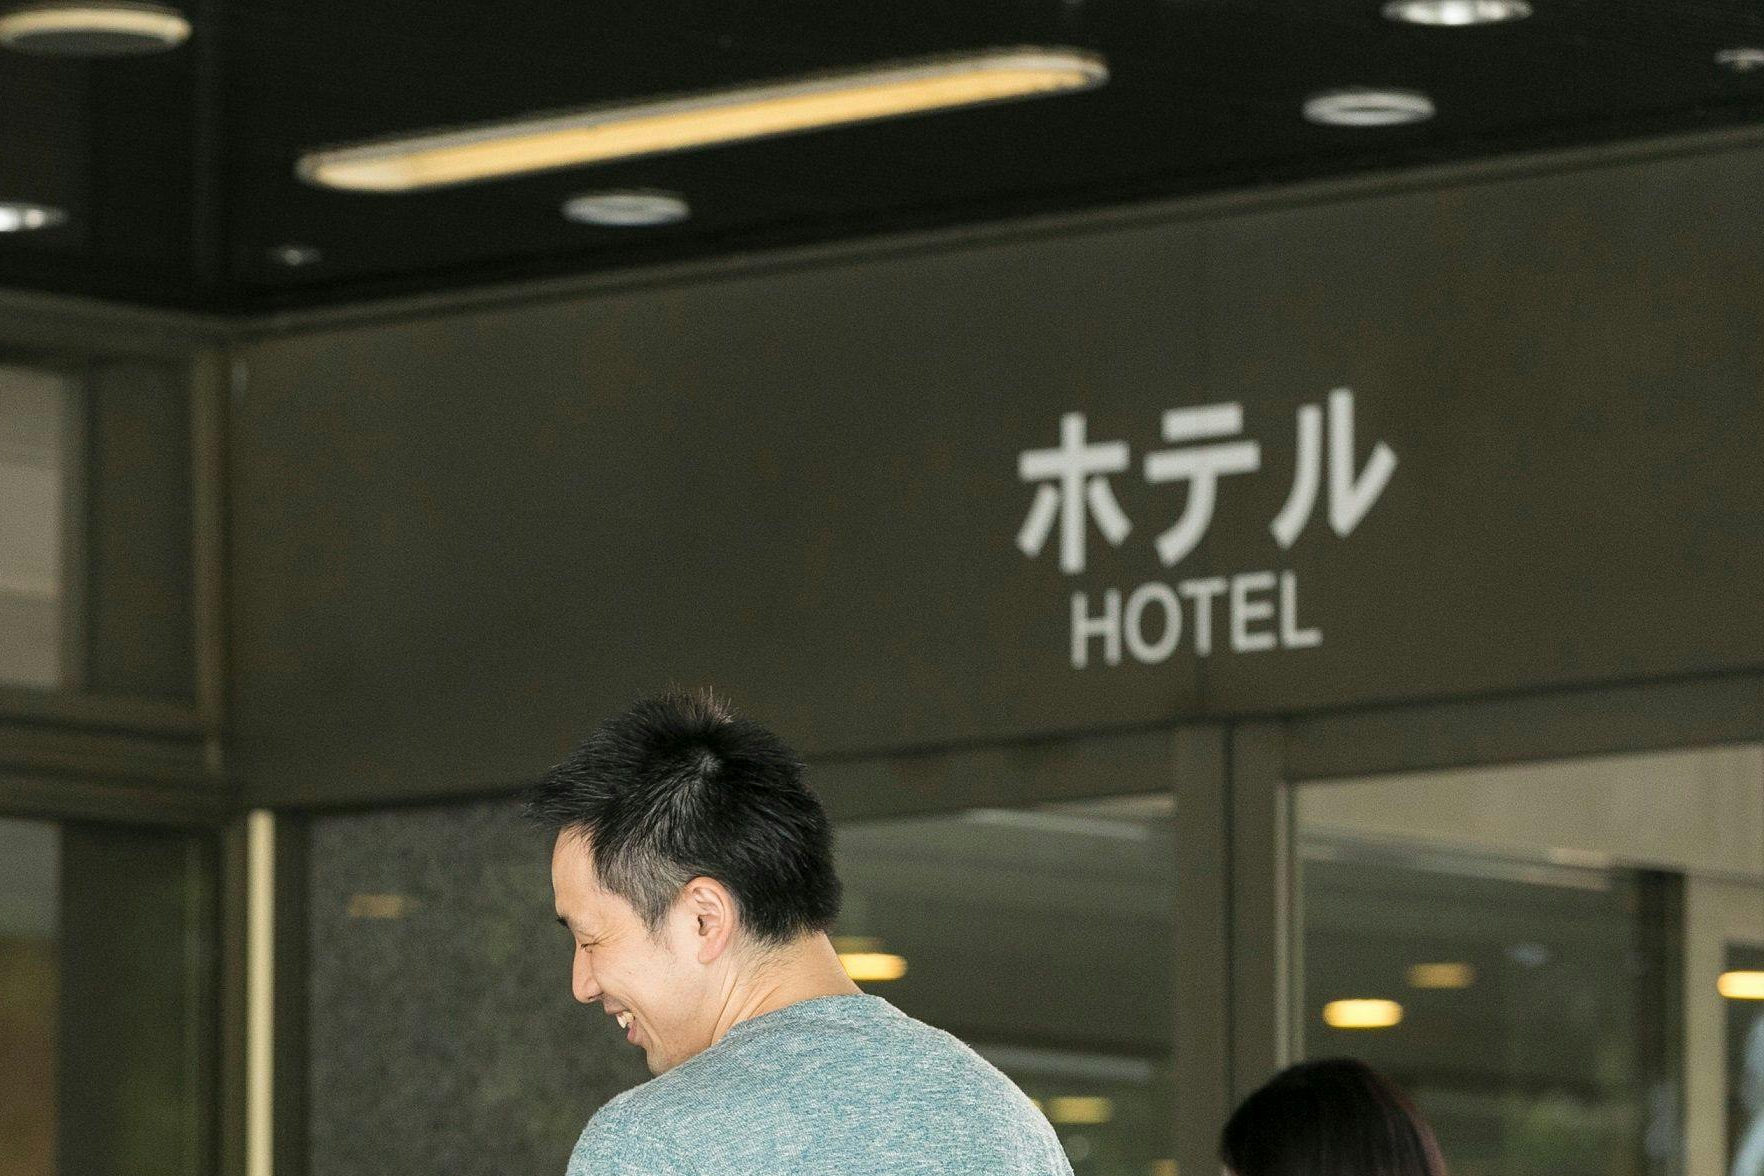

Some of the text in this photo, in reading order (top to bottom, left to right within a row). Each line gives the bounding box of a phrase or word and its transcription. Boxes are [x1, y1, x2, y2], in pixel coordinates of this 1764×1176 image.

[1016, 387, 1398, 575] ホテル
[1069, 570, 1323, 670] HOTEL
